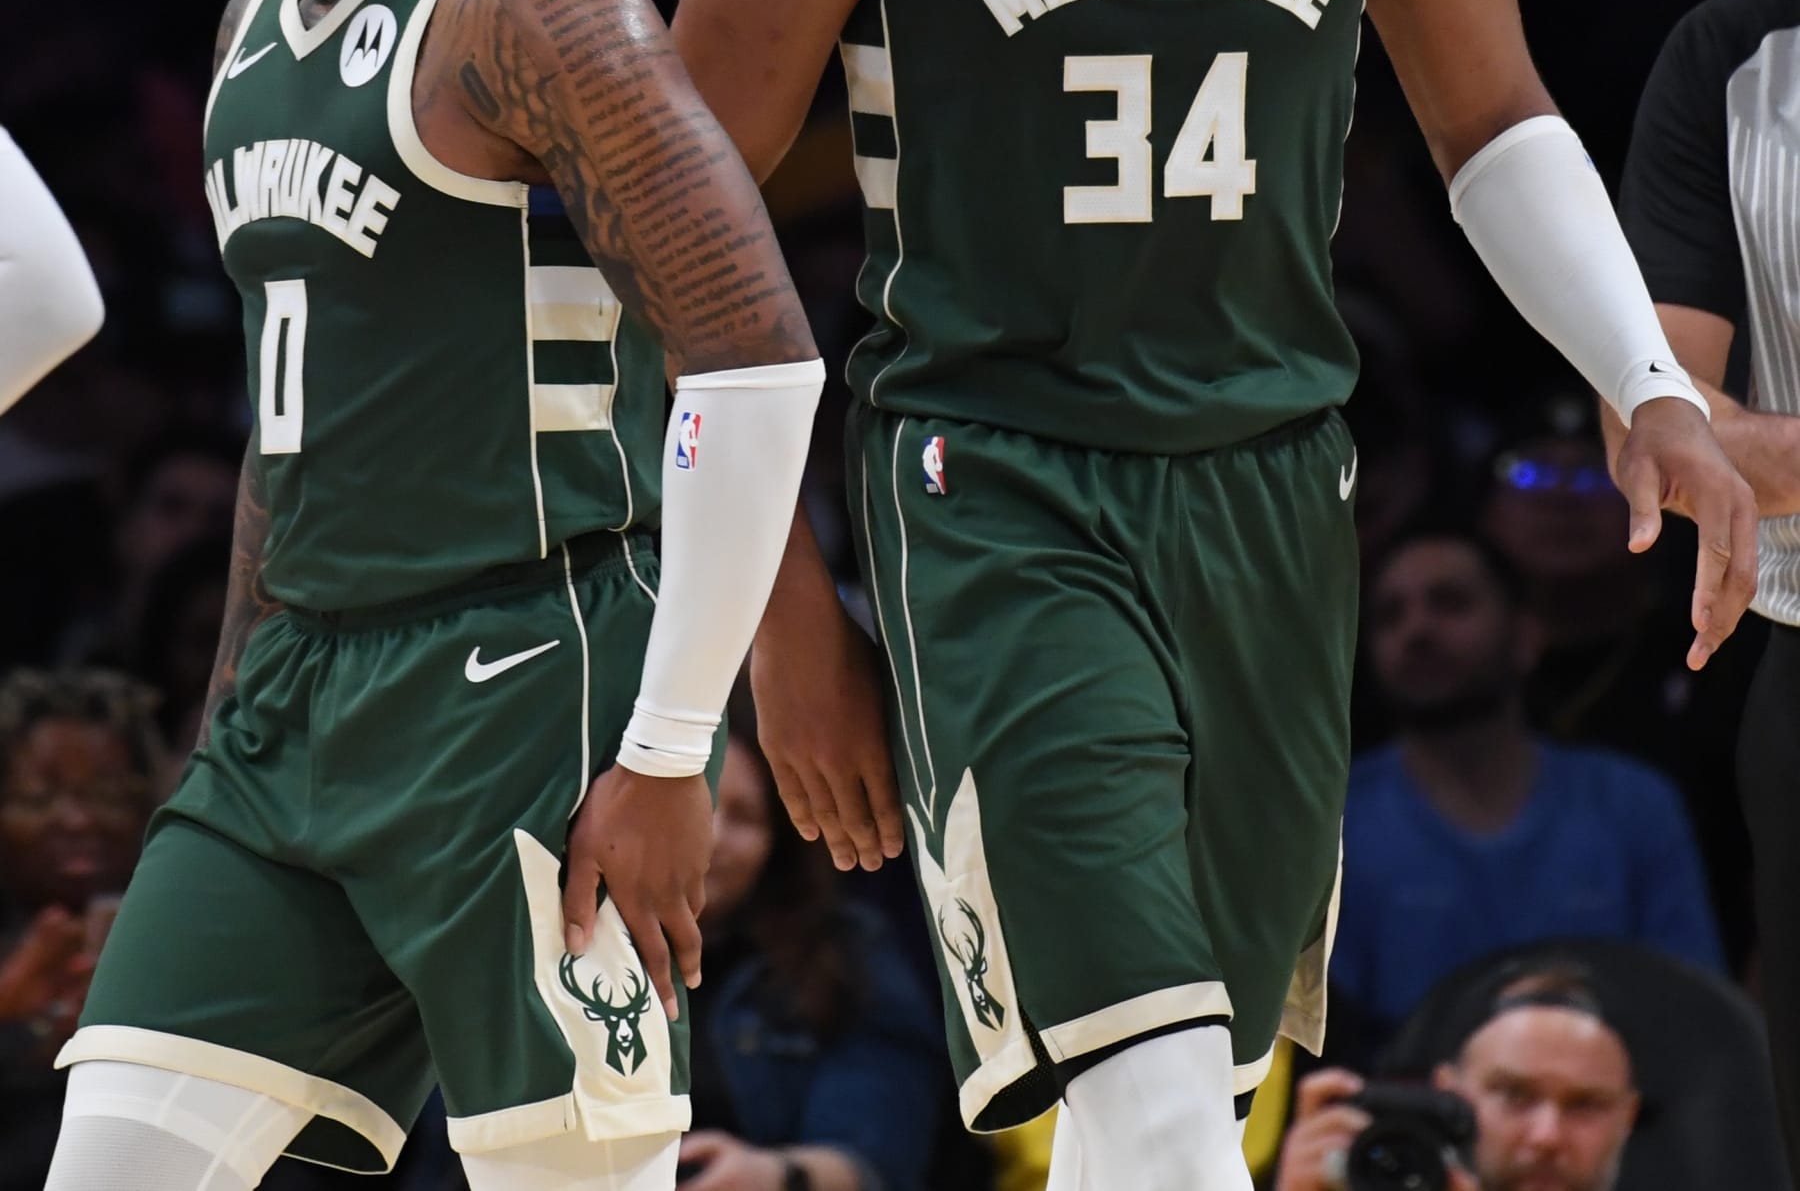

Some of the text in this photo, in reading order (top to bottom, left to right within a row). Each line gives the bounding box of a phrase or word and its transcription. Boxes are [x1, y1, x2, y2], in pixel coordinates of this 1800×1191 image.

[205, 138, 401, 259] ILWAUKEE
[1063, 51, 1257, 224] 34
[259, 278, 308, 455] 0
